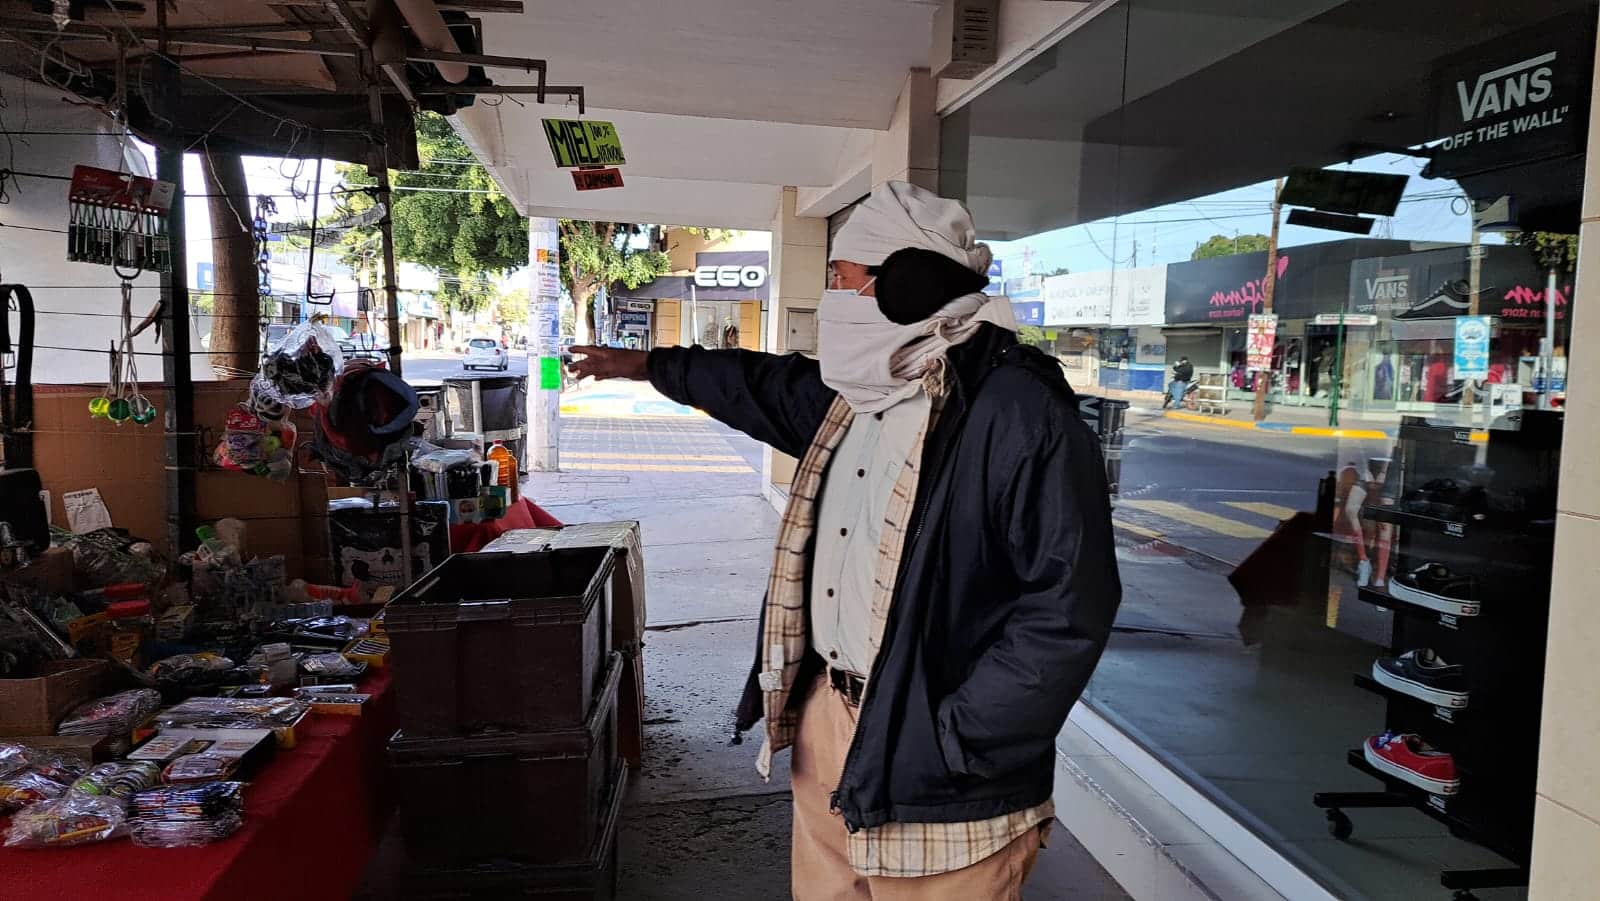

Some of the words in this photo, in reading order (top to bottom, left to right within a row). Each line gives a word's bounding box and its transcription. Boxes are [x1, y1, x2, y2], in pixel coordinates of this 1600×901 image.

[1457, 51, 1557, 122] VANS
[545, 119, 600, 167] MIEL
[1477, 121, 1509, 143] THE
[694, 265, 767, 288] EGO
[1366, 274, 1409, 300] VANS
